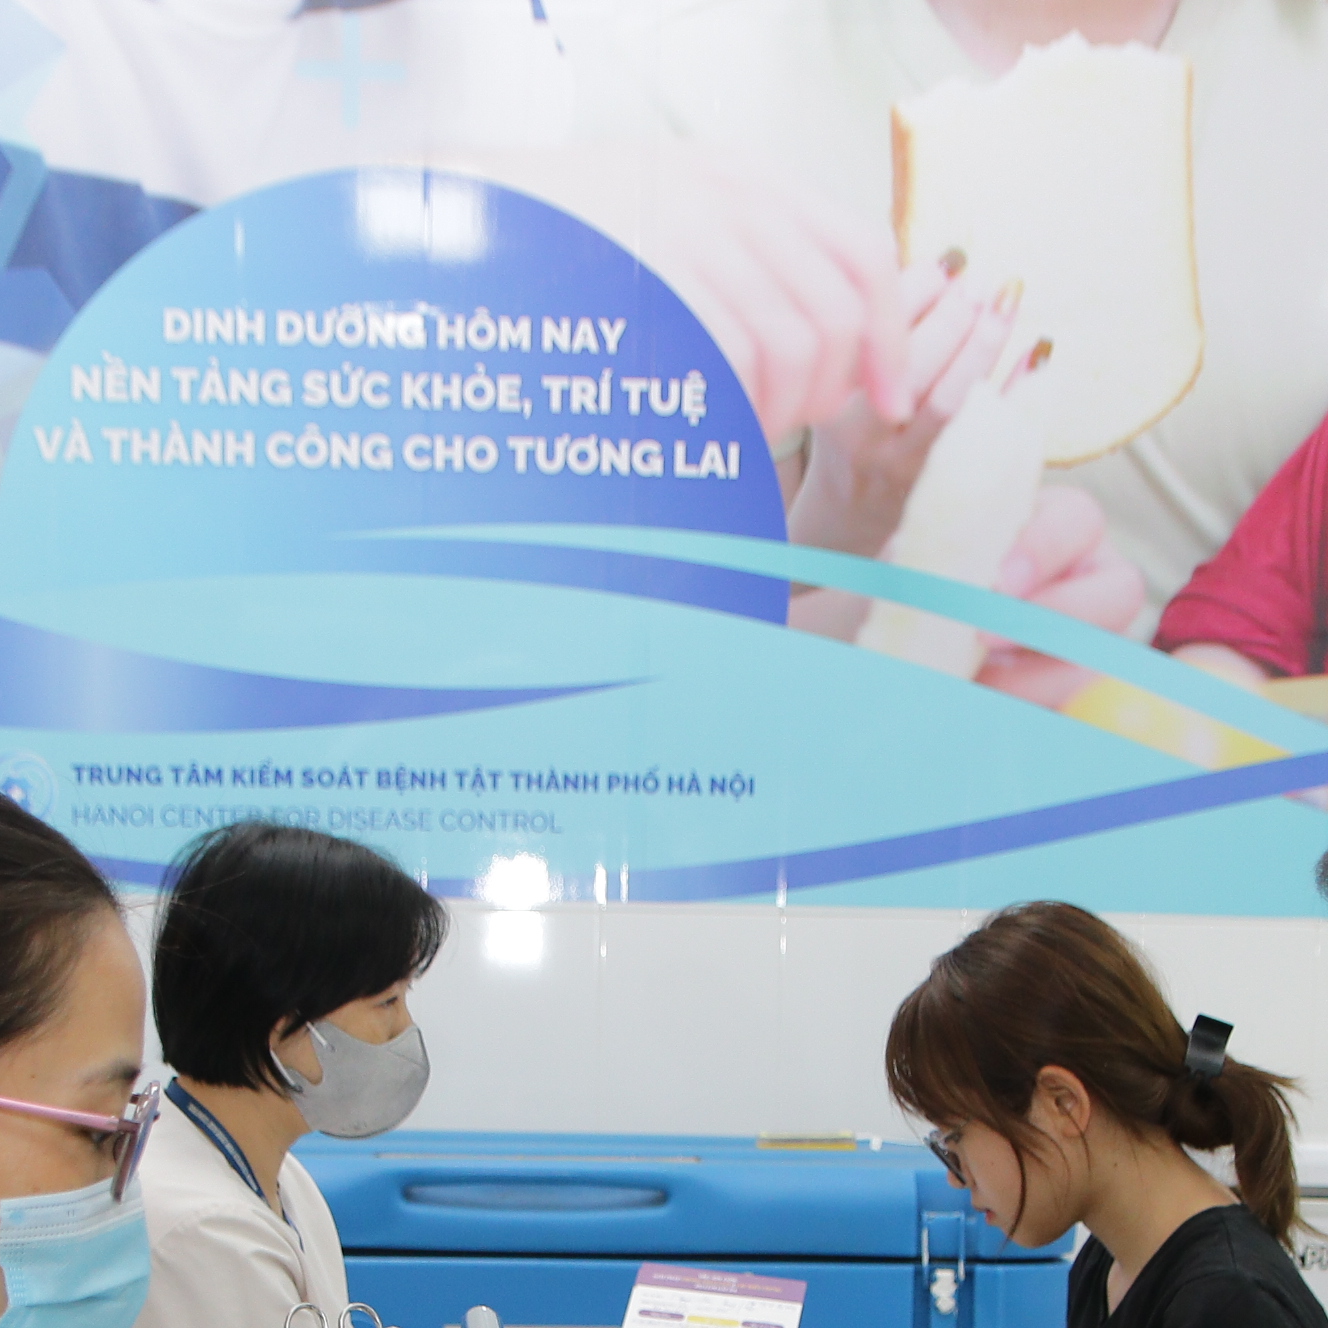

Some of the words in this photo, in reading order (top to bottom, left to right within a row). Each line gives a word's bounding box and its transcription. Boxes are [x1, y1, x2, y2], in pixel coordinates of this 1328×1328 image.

[163, 306, 267, 346] DINH
[276, 302, 427, 349] DƯỠNG
[437, 306, 532, 352] HÔM
[542, 316, 628, 355] NAY
[72, 350, 162, 404] NỀN
[171, 356, 293, 407] TẢNG
[302, 360, 391, 410] SỨC
[401, 362, 533, 420] KHỎE,
[542, 367, 613, 415] TRÍ
[621, 370, 707, 427] TUỆ
[33, 417, 94, 464] VÀ
[101, 419, 255, 468] THÀNH
[265, 422, 393, 471] CÔNG
[402, 433, 499, 475] CHO
[506, 432, 665, 478] TƯƠNG
[674, 439, 740, 480] LAI
[73, 763, 163, 786] TRUNG
[171, 759, 222, 787] TÂM
[232, 758, 293, 788] KIỂM
[301, 763, 369, 789] SOÁT
[377, 764, 446, 796] BỆNH
[455, 764, 503, 797] TẬT
[510, 765, 599, 793] THÀNH
[607, 764, 660, 795] PHỐ
[668, 769, 701, 796] HÀ
[710, 769, 755, 802] NỘI
[73, 804, 154, 827] HANOI
[160, 804, 263, 828] CENTER
[271, 805, 321, 828] FOR
[328, 806, 432, 832] DISEASE
[439, 808, 563, 834] CONTROL
